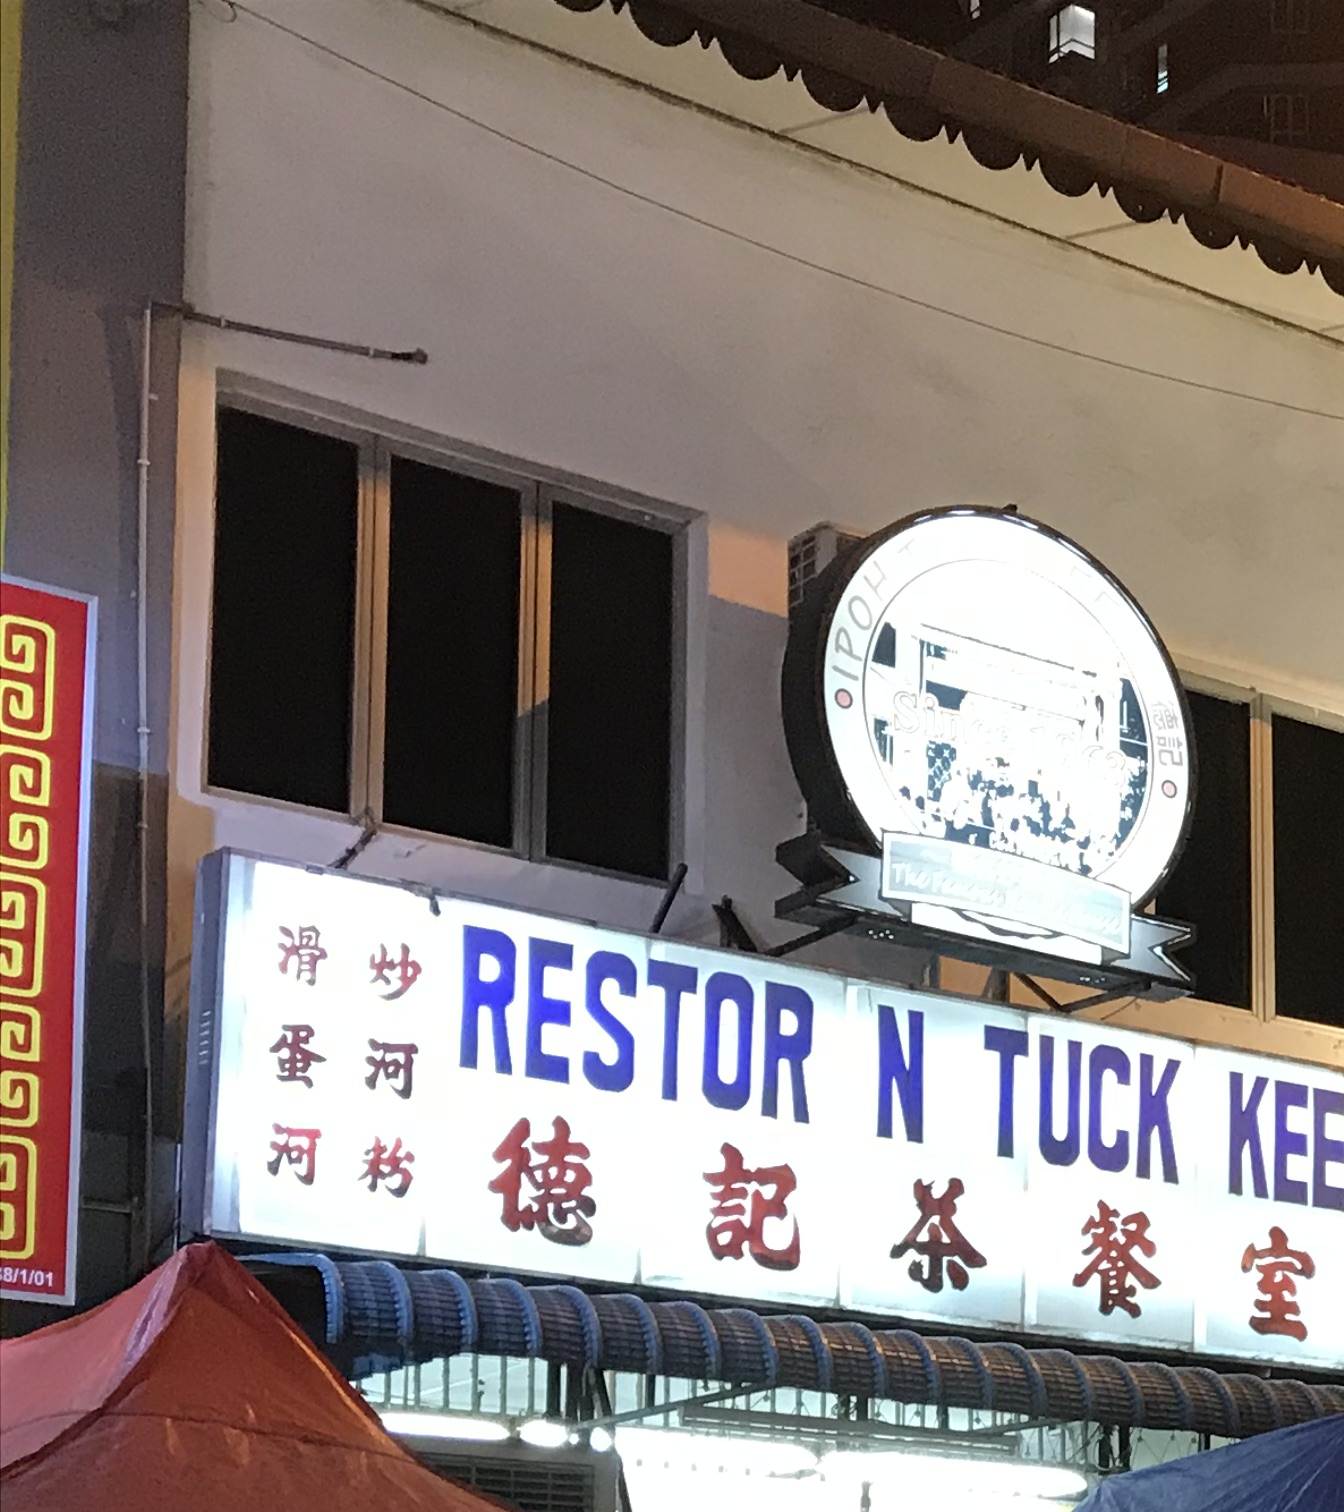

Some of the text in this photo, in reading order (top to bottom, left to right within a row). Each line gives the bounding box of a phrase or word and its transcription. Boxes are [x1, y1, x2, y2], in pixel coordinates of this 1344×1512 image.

[267, 923, 327, 1188] 滑蛋河
[459, 924, 814, 1124] RESTOR
[877, 1005, 924, 1143] N
[983, 1024, 1181, 1185] TUCK
[489, 1116, 1316, 1343] 德記茶餐室
